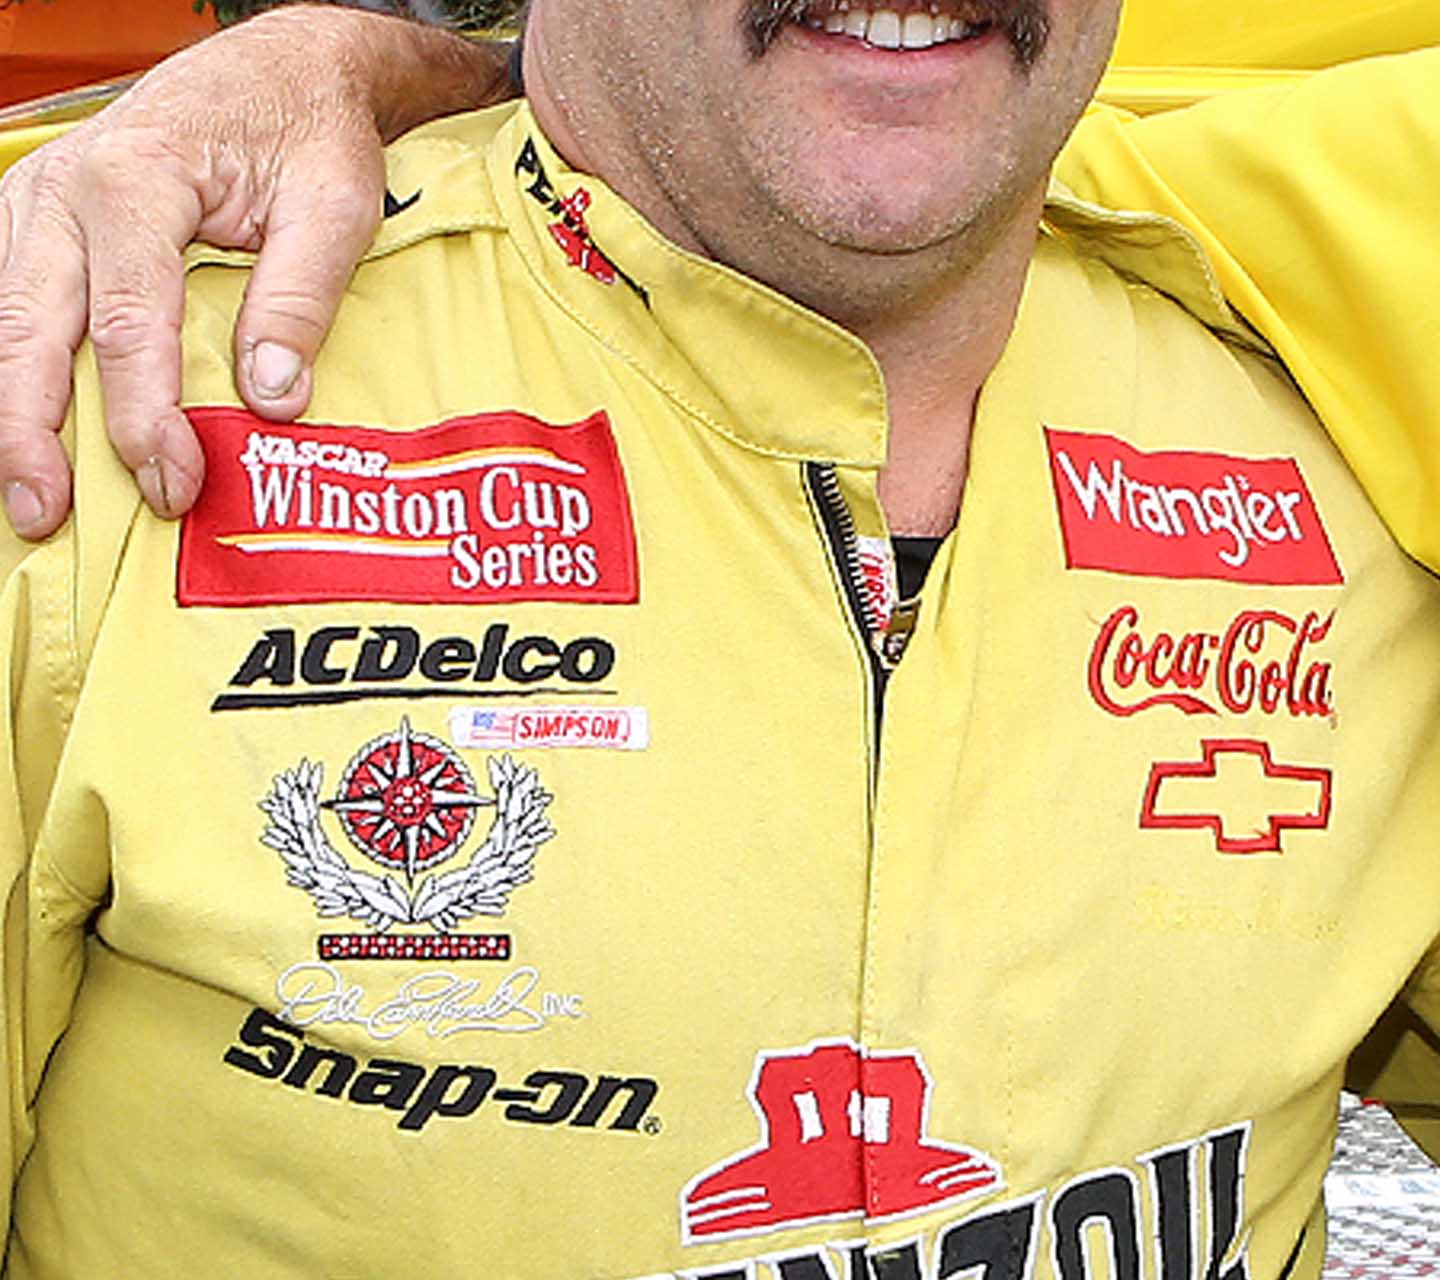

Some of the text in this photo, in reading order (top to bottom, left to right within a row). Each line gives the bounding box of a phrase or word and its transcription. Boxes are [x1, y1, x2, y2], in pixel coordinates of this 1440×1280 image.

[240, 432, 388, 478] NASCAR
[248, 463, 591, 538] Winston Cup
[1056, 449, 1302, 566] Wrangler
[450, 531, 600, 588] Series
[228, 623, 616, 686] ACDelco
[1088, 606, 1337, 718] Coca-Cola
[518, 715, 617, 743] SIMPSON
[223, 1007, 658, 1131] Snap-on
